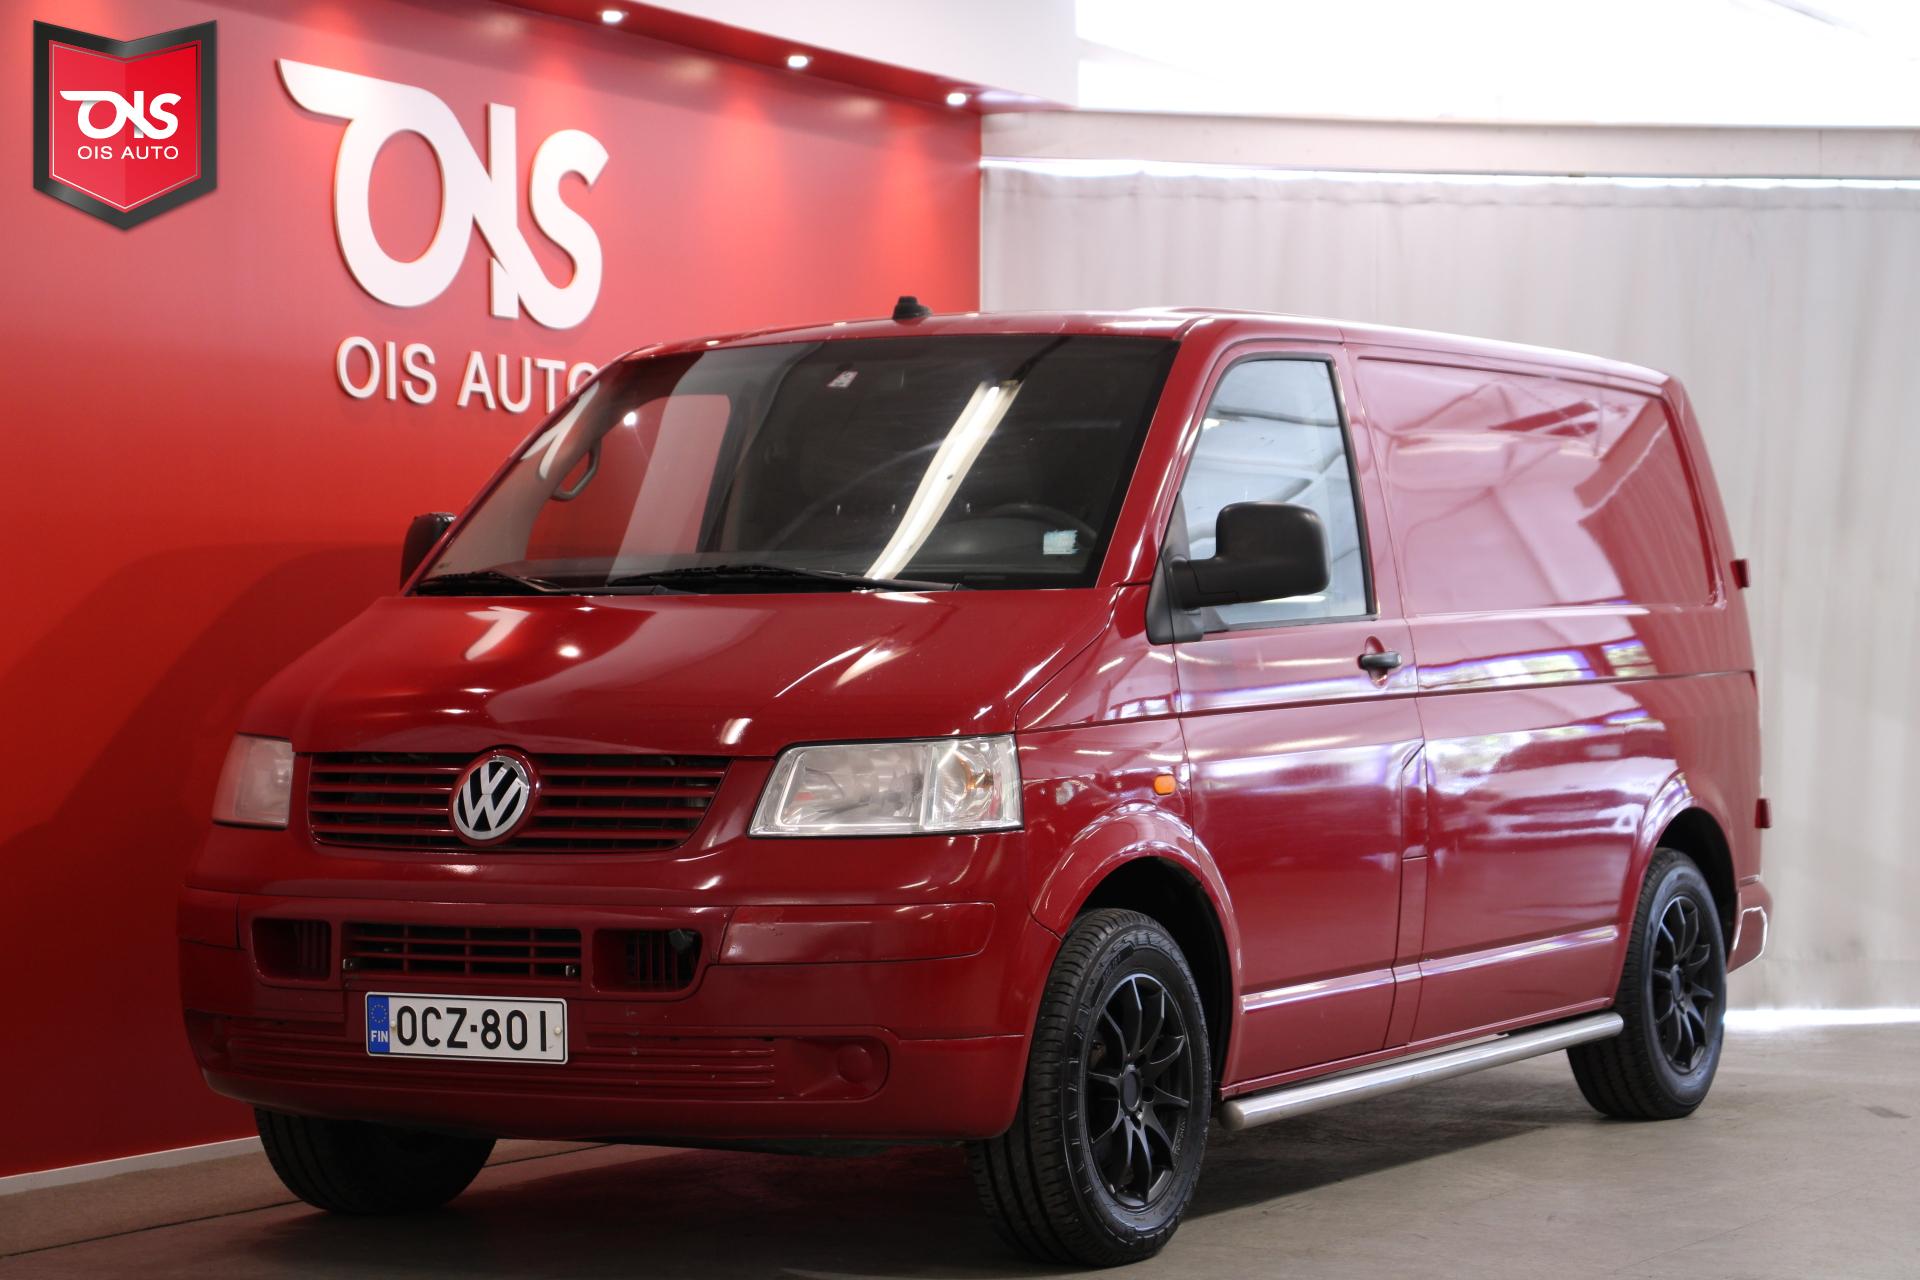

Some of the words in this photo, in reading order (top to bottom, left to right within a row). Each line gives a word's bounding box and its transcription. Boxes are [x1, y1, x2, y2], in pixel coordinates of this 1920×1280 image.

[278, 59, 609, 330] OIS
[336, 336, 437, 405] OIS
[371, 1030, 389, 1043] FIN
[397, 1005, 547, 1052] OCZ-801
